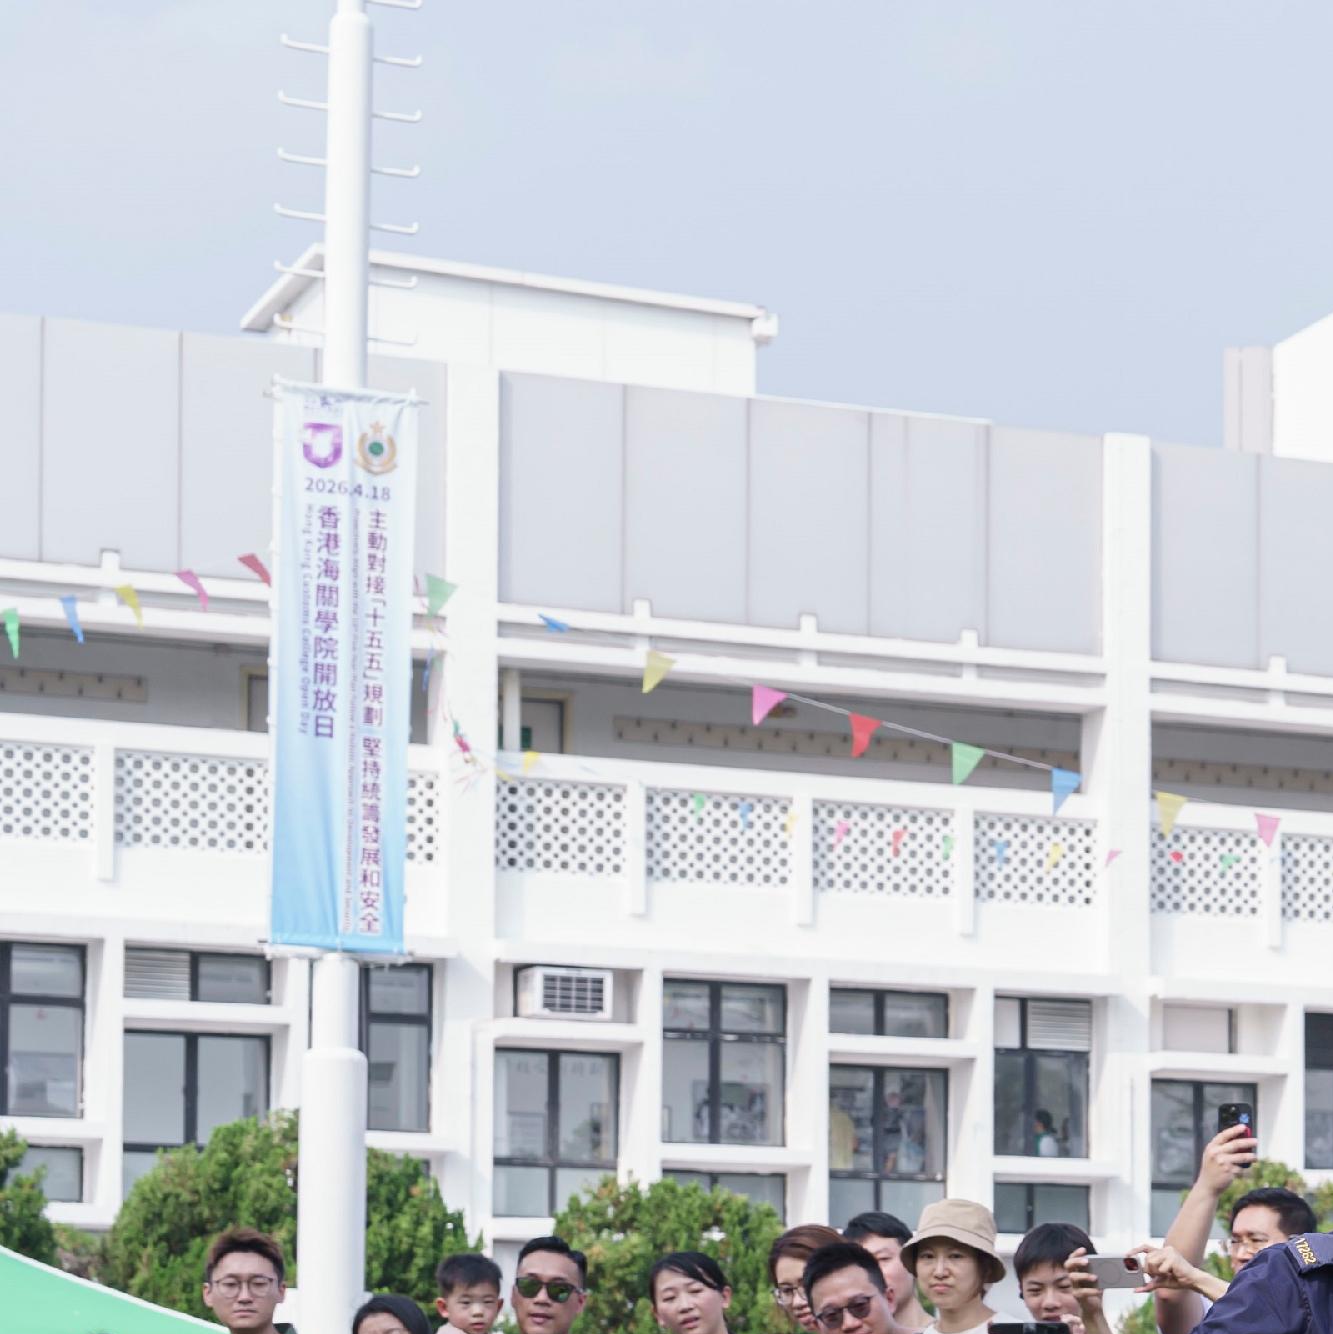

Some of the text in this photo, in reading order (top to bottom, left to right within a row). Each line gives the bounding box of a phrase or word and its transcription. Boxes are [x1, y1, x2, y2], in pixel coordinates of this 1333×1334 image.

[305, 476, 391, 502] 2026.4.18
[312, 506, 341, 740] 香港海關學院開放日
